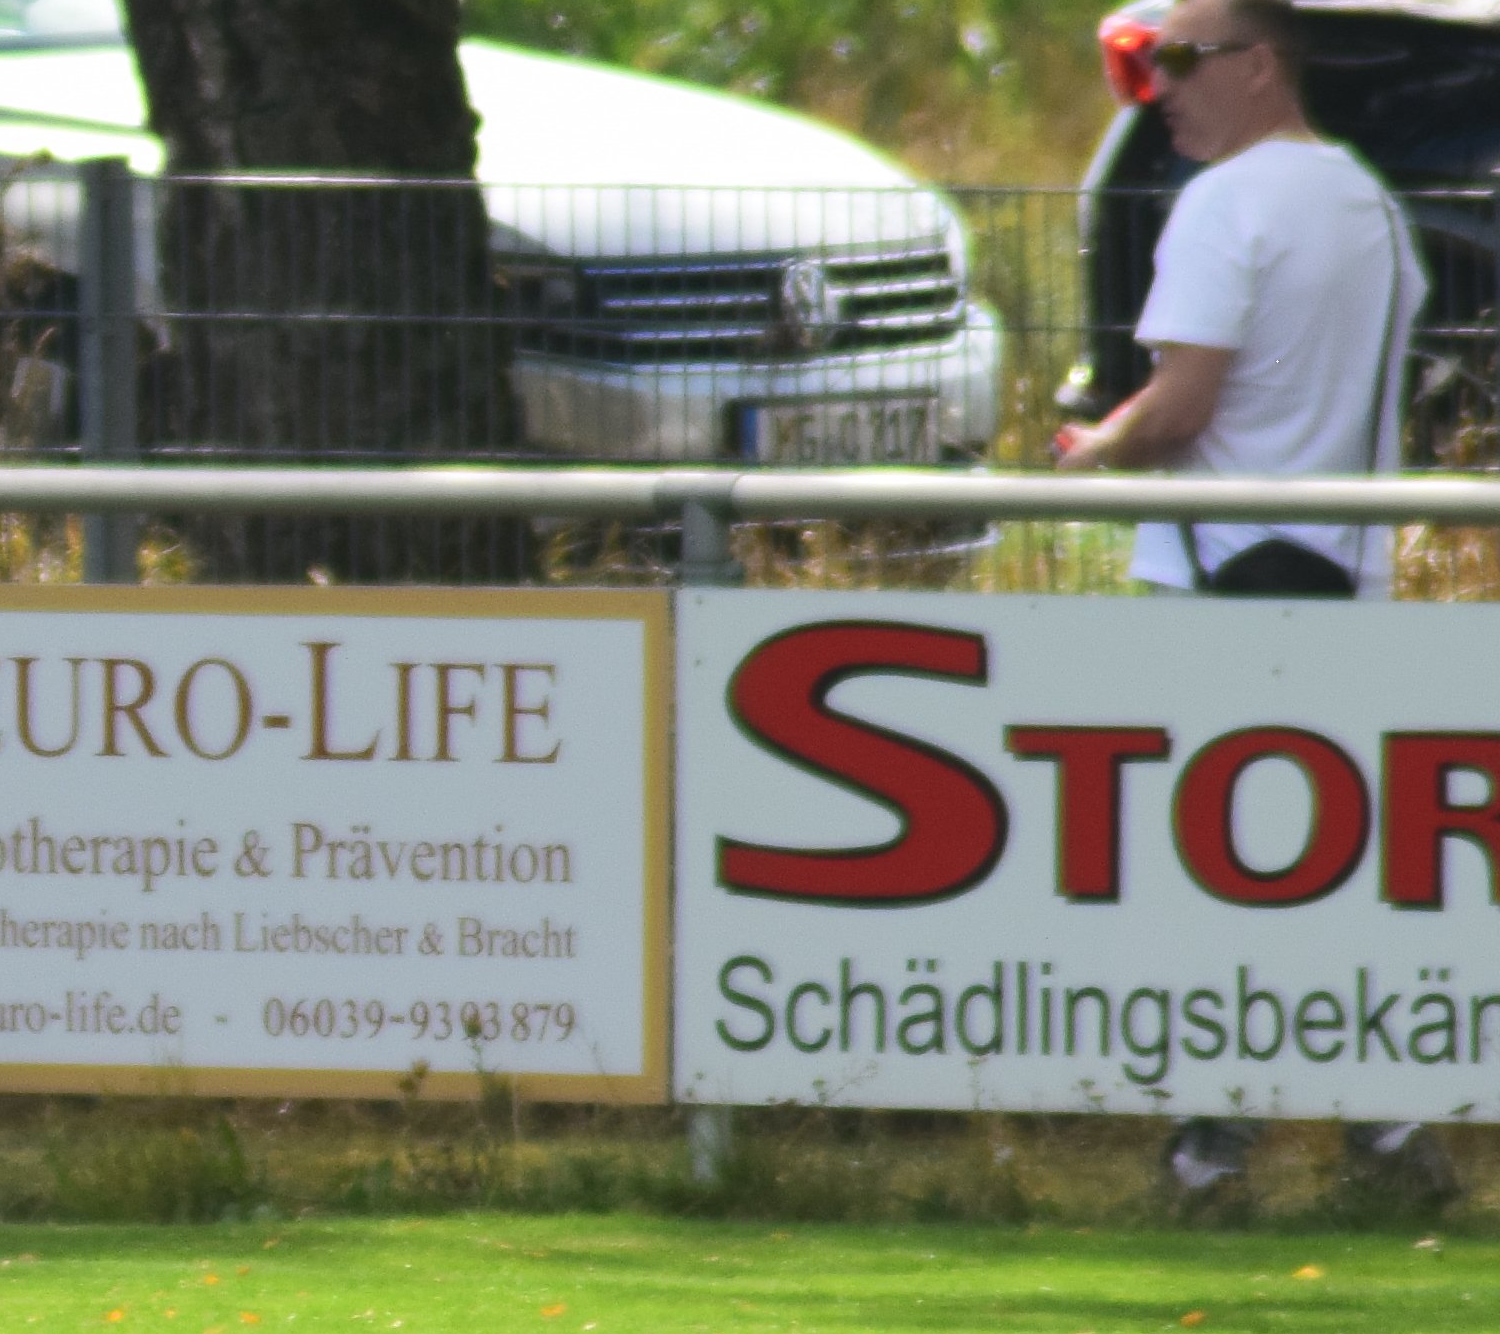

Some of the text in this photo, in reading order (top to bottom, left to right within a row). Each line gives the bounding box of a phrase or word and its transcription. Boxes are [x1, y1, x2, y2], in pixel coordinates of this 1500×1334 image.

[233, 830, 273, 878] &
[291, 822, 573, 885] Prävention
[140, 913, 222, 953] nach
[234, 911, 408, 958] Liebscher
[417, 922, 442, 957] &
[457, 916, 578, 960] Bracht
